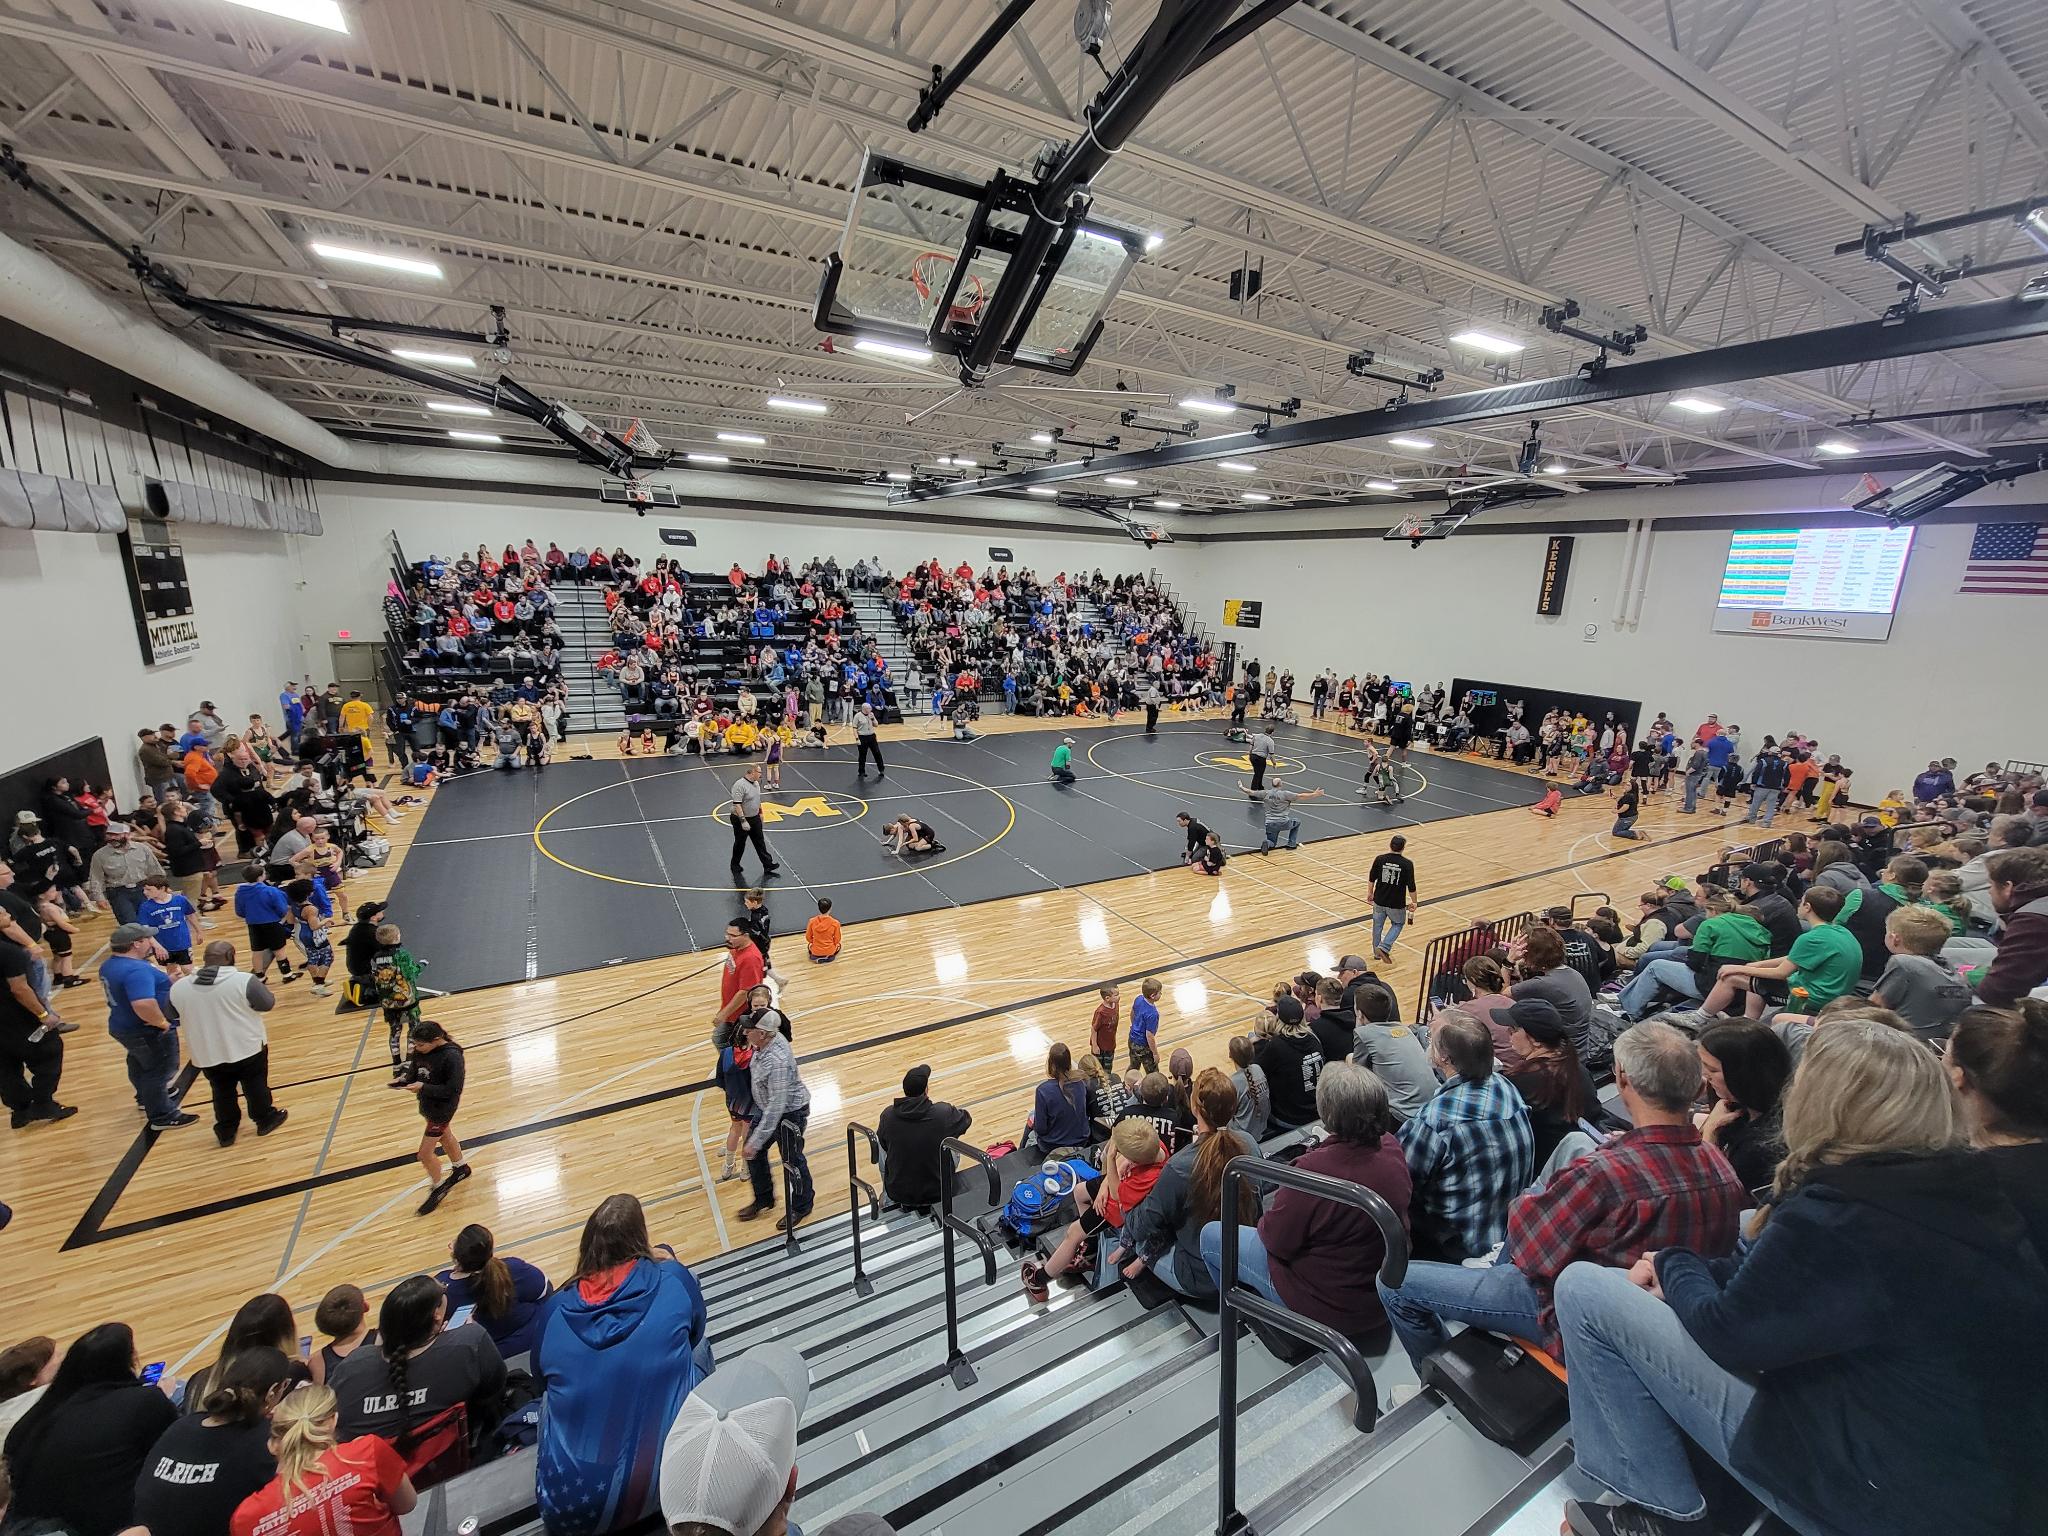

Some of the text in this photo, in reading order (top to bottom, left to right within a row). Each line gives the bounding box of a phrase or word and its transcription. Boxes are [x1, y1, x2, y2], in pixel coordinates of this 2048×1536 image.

[1541, 540, 1560, 611] KERNELS
[1772, 614, 1847, 627] BankWest
[150, 621, 198, 648] MITCHELL
[760, 796, 842, 822] M
[363, 1387, 428, 1414] ULRCH
[154, 1456, 220, 1484] ULRICH
